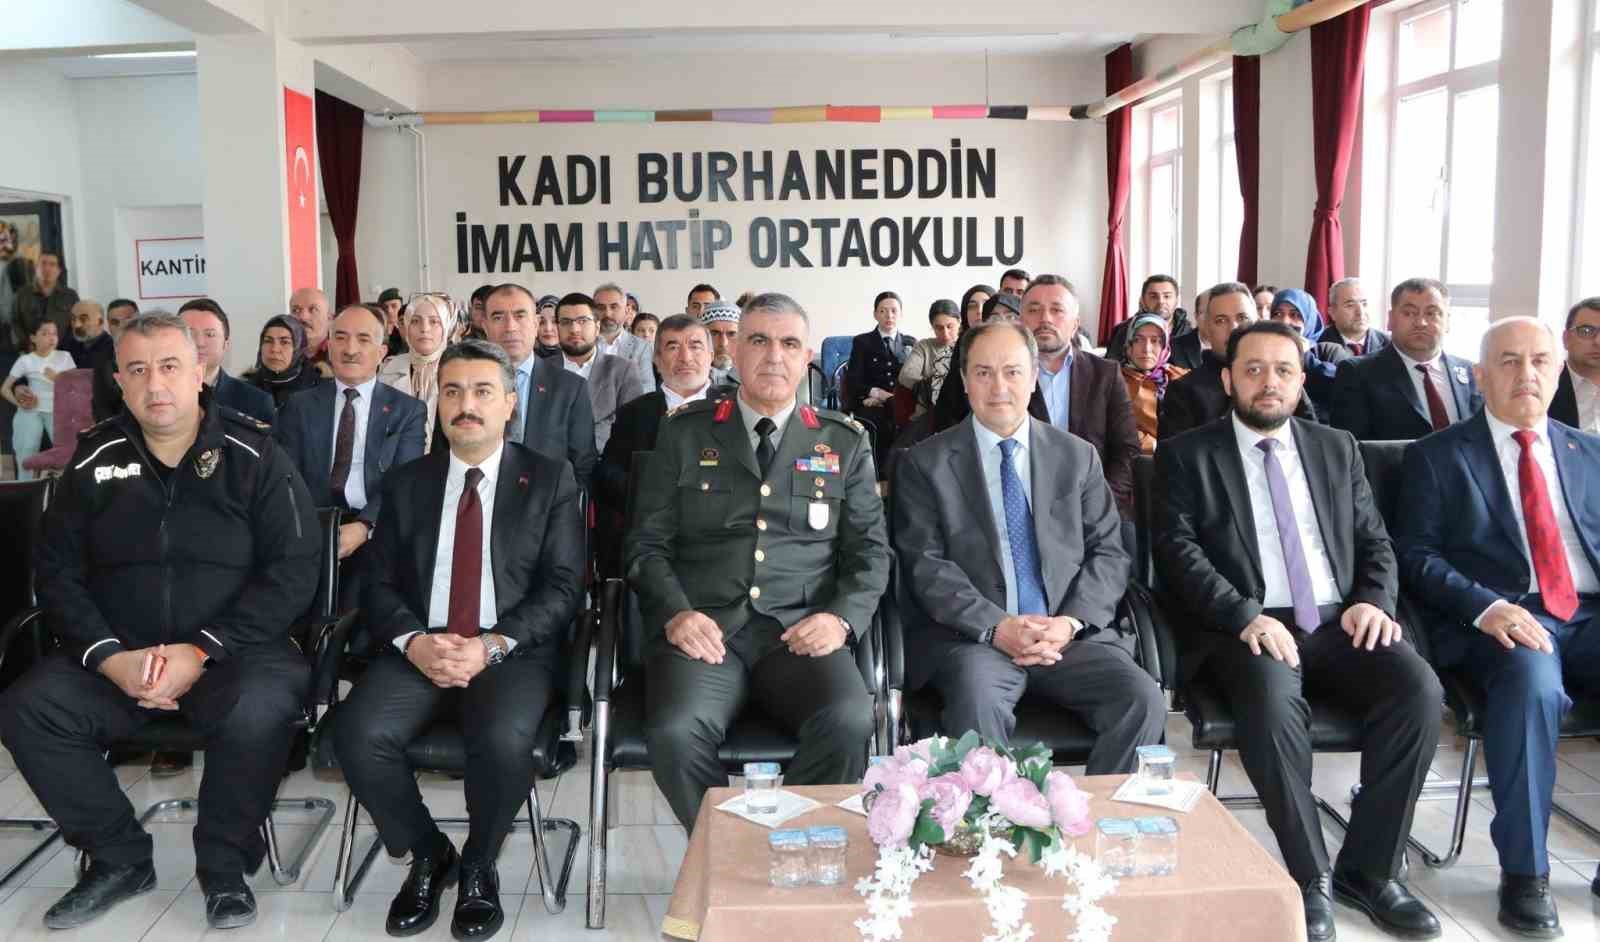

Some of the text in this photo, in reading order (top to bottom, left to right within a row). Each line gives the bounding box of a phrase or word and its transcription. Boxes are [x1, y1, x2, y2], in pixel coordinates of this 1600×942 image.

[498, 138, 996, 206] KADI BURHANEDDİN
[456, 209, 1024, 274] İMAM HATİP ORTAOKULU
